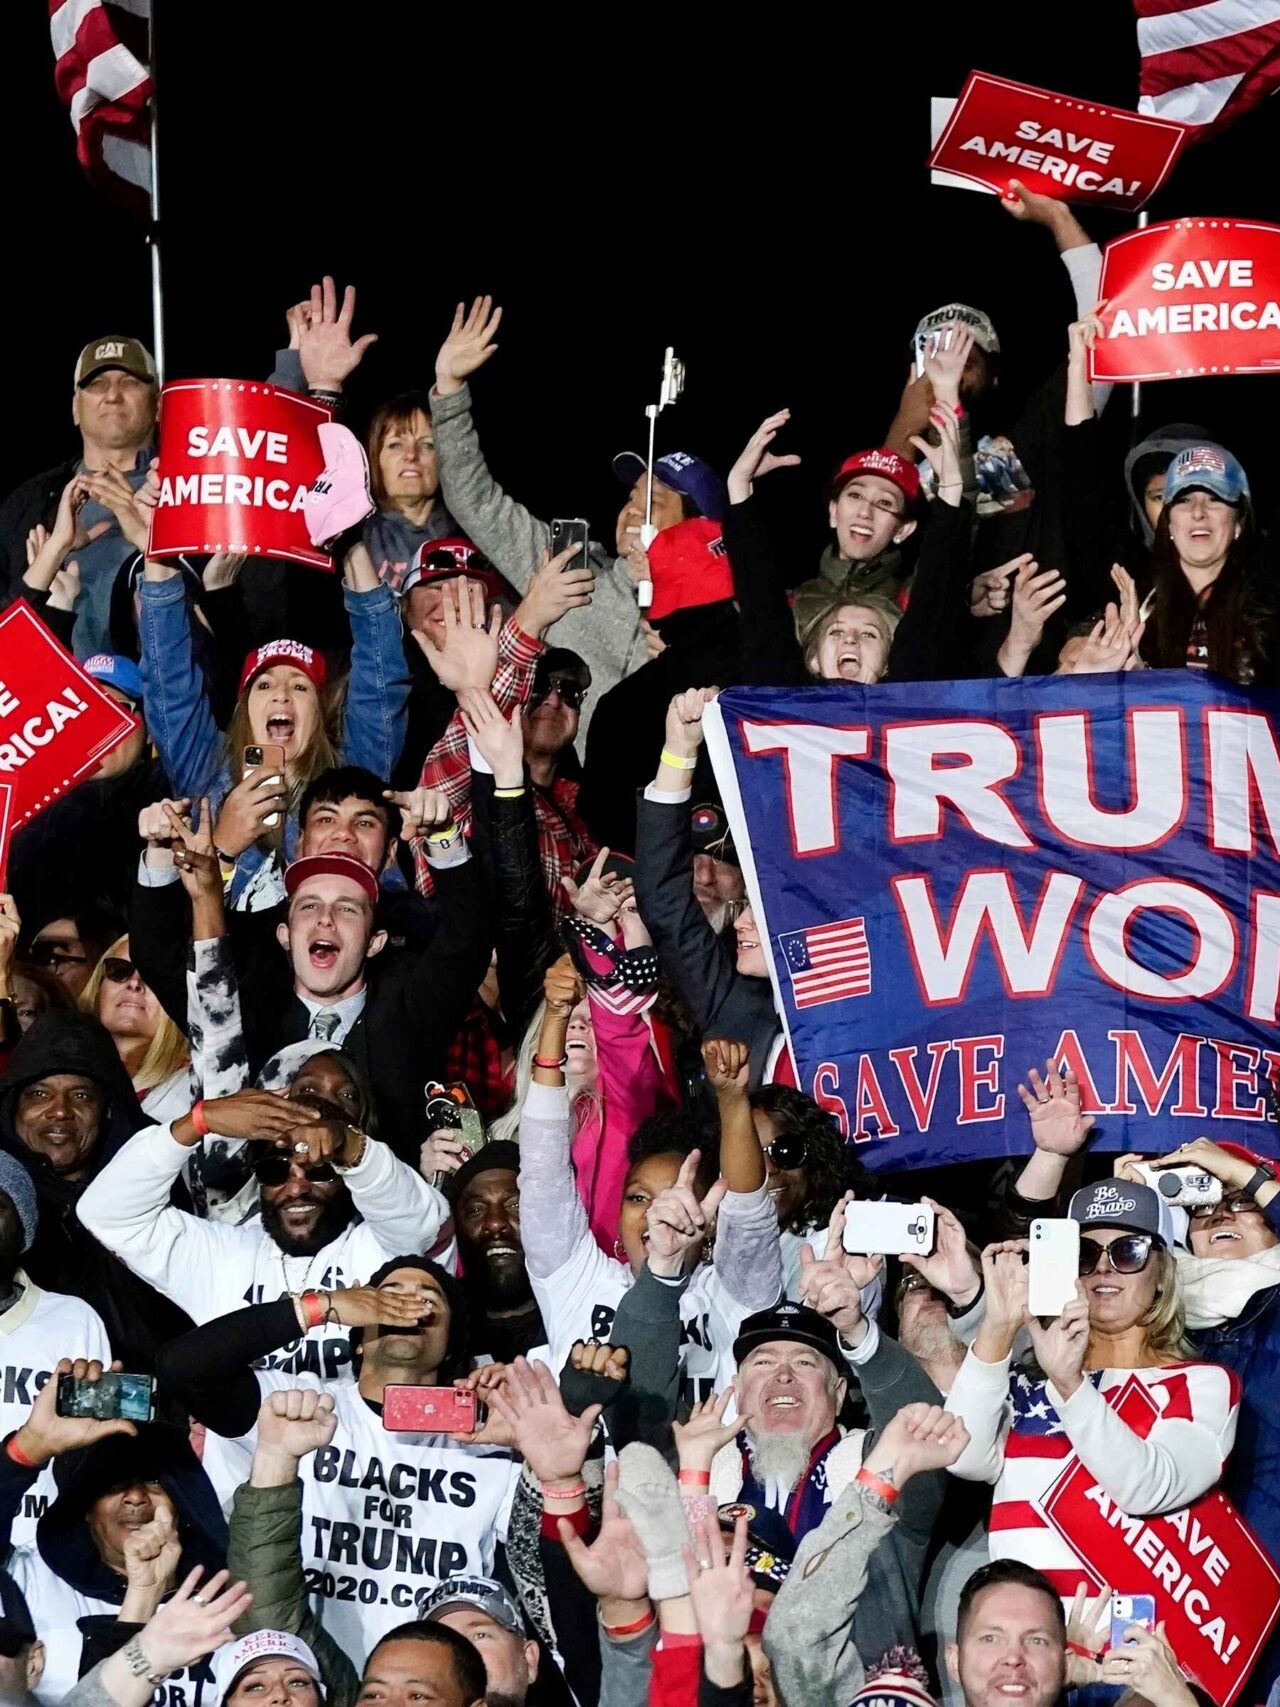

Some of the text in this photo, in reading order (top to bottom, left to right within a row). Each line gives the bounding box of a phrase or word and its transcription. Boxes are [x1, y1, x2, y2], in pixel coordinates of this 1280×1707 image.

[1015, 121, 1115, 164] SAVE
[959, 136, 1142, 196] AMERICA!
[1151, 260, 1253, 291] SAVE
[926, 309, 981, 328] TRUMP
[95, 342, 126, 360] CAT
[187, 426, 289, 464] SAVE
[158, 474, 310, 513] AMERICA
[812, 1034, 1005, 1145] SAVE
[1085, 1199, 1136, 1219] Brave
[1094, 1186, 1119, 1201] Be
[313, 1445, 477, 1508] BLACKS
[363, 1495, 413, 1529] FOR
[310, 1515, 468, 1581] TRUMP
[1083, 1485, 1241, 1665] AMERICA!
